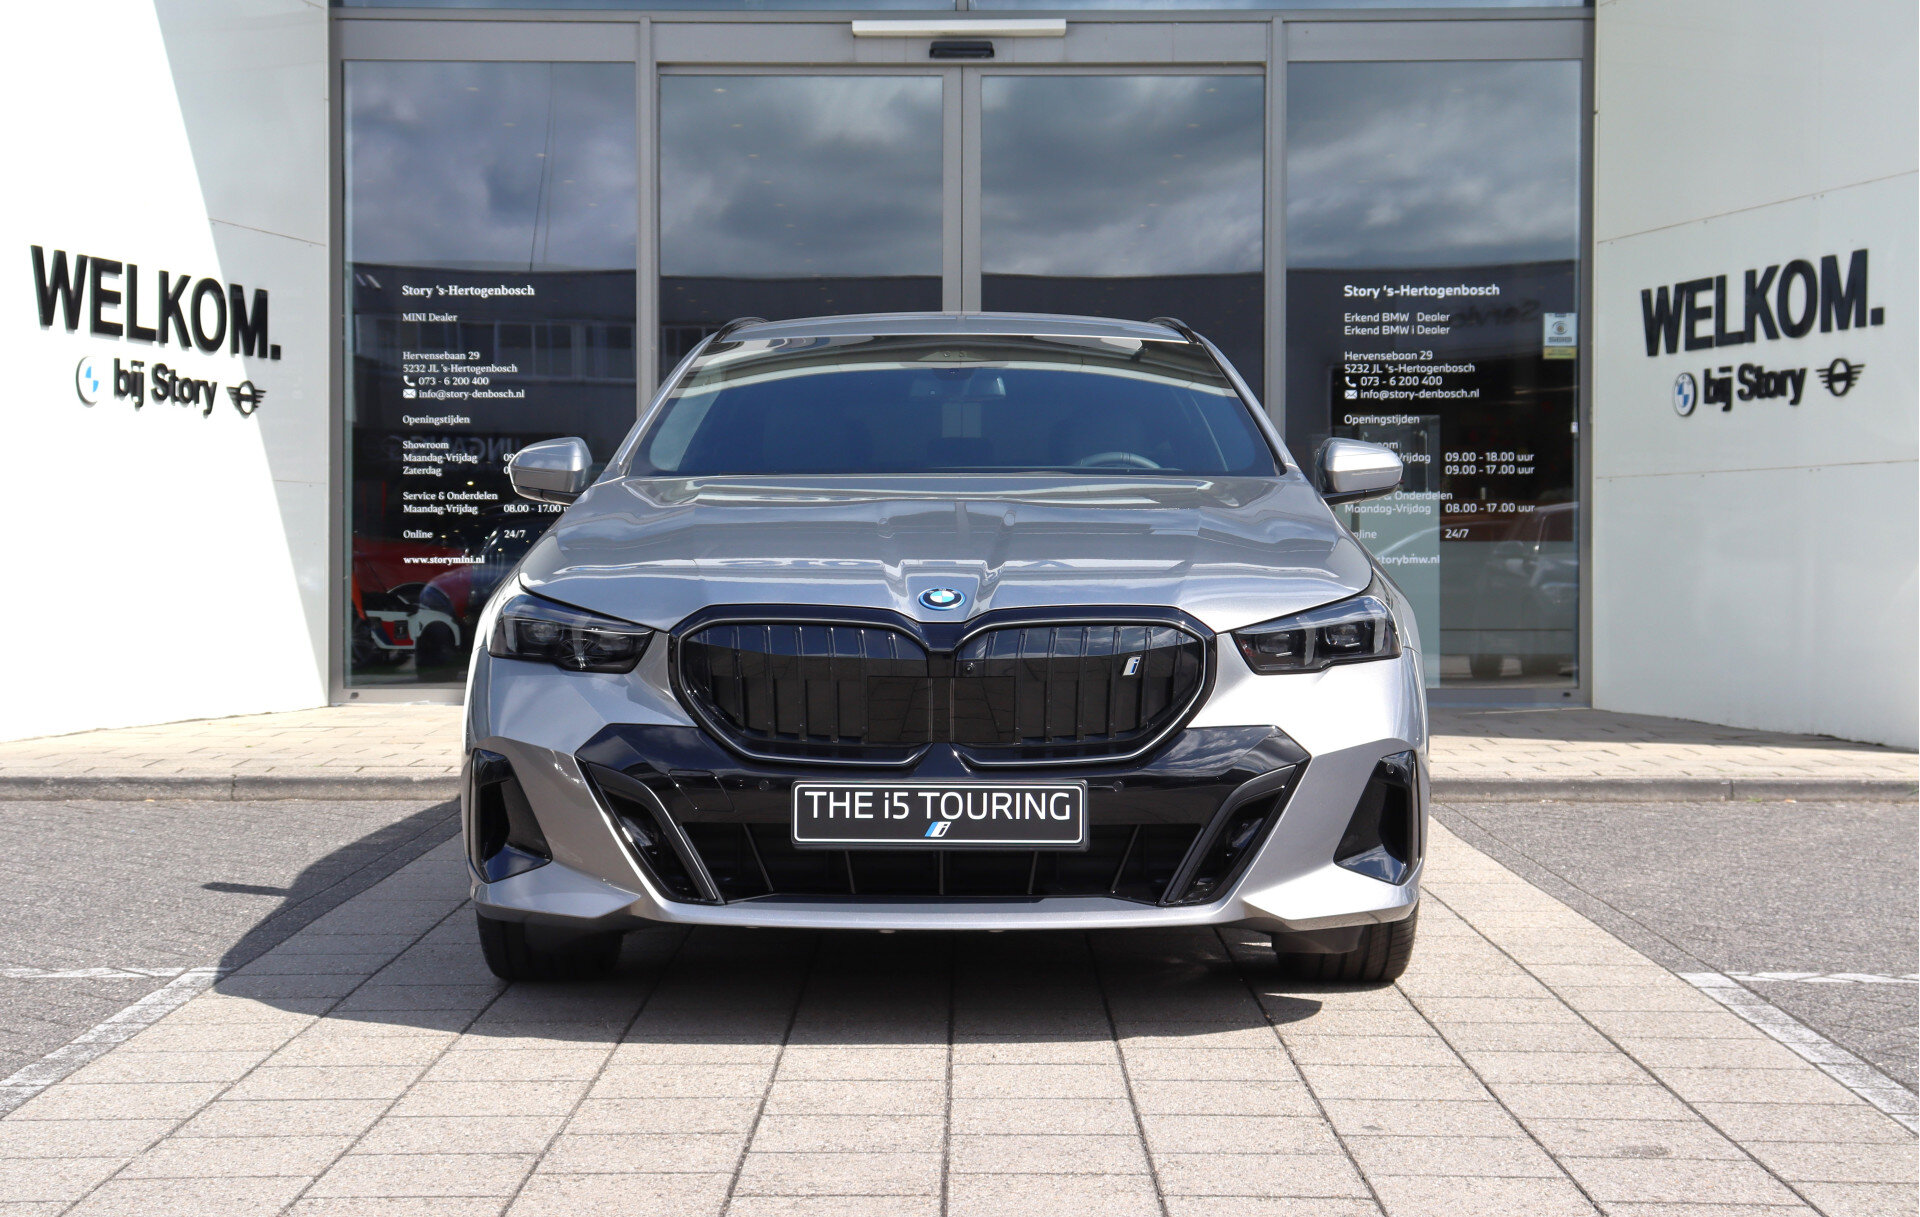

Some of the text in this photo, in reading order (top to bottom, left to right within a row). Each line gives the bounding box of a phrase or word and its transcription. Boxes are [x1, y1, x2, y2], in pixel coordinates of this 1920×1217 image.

[402, 285, 535, 298] Story 's-Hertogenbosch
[1344, 284, 1500, 299] Story 's-Hertogenbosch
[31, 245, 281, 360] WELKOM.
[1641, 248, 1885, 357] WELKOM.
[402, 313, 458, 322] MINI Dealer
[1344, 312, 1450, 322] Erkend BMW Dealer
[1344, 325, 1380, 335] Erkend
[1382, 325, 1410, 335] BMW
[1417, 325, 1450, 335] Dealer
[402, 351, 480, 360] Hervensebaan 29
[1344, 351, 1433, 361] Hervensebaan 29
[403, 364, 518, 375] 5232 JL 's-Hertogenbosch
[1344, 363, 1475, 376] 5232 JL 's-Hertogenbosch
[418, 376, 436, 385] 073
[443, 376, 450, 385] 6
[452, 376, 470, 385] 200
[471, 376, 489, 385] 400
[1360, 376, 1380, 386] 073
[1389, 376, 1396, 386] 6
[1398, 376, 1419, 386] 200
[1421, 376, 1443, 386] 400
[114, 358, 217, 416] bij Story
[1704, 363, 1808, 412] bij Story
[418, 389, 525, 400] info@story-denbosch.nl
[1360, 389, 1480, 400] info@story-denbosch.nl
[402, 415, 470, 426] Openingstijden
[1344, 414, 1420, 426] Openingstijden
[402, 441, 449, 449] Showroom
[403, 453, 478, 464] Maandag-Vrijdag
[1445, 452, 1476, 462] 09.00
[1486, 452, 1515, 462] 18.00
[1517, 453, 1534, 462] uur
[403, 466, 442, 476] Zaterdag
[1445, 465, 1476, 475] 09.00
[1517, 466, 1535, 474] uur
[403, 491, 498, 500] Service & Onderdelen
[1395, 491, 1453, 500] Onderdelen
[403, 504, 478, 515] Maandag-Vrijdag
[504, 505, 529, 513] 08.00
[537, 505, 561, 513] 17.00
[1344, 504, 1431, 515] Maandag-Vrijdag
[1445, 503, 1477, 513] 08.00
[1518, 504, 1535, 513] uur
[403, 530, 526, 539] Online 24/7
[1354, 529, 1470, 539] nline 24/7
[403, 555, 485, 565] www.storymini.nl
[804, 791, 1070, 820] THE i5 TOURING
